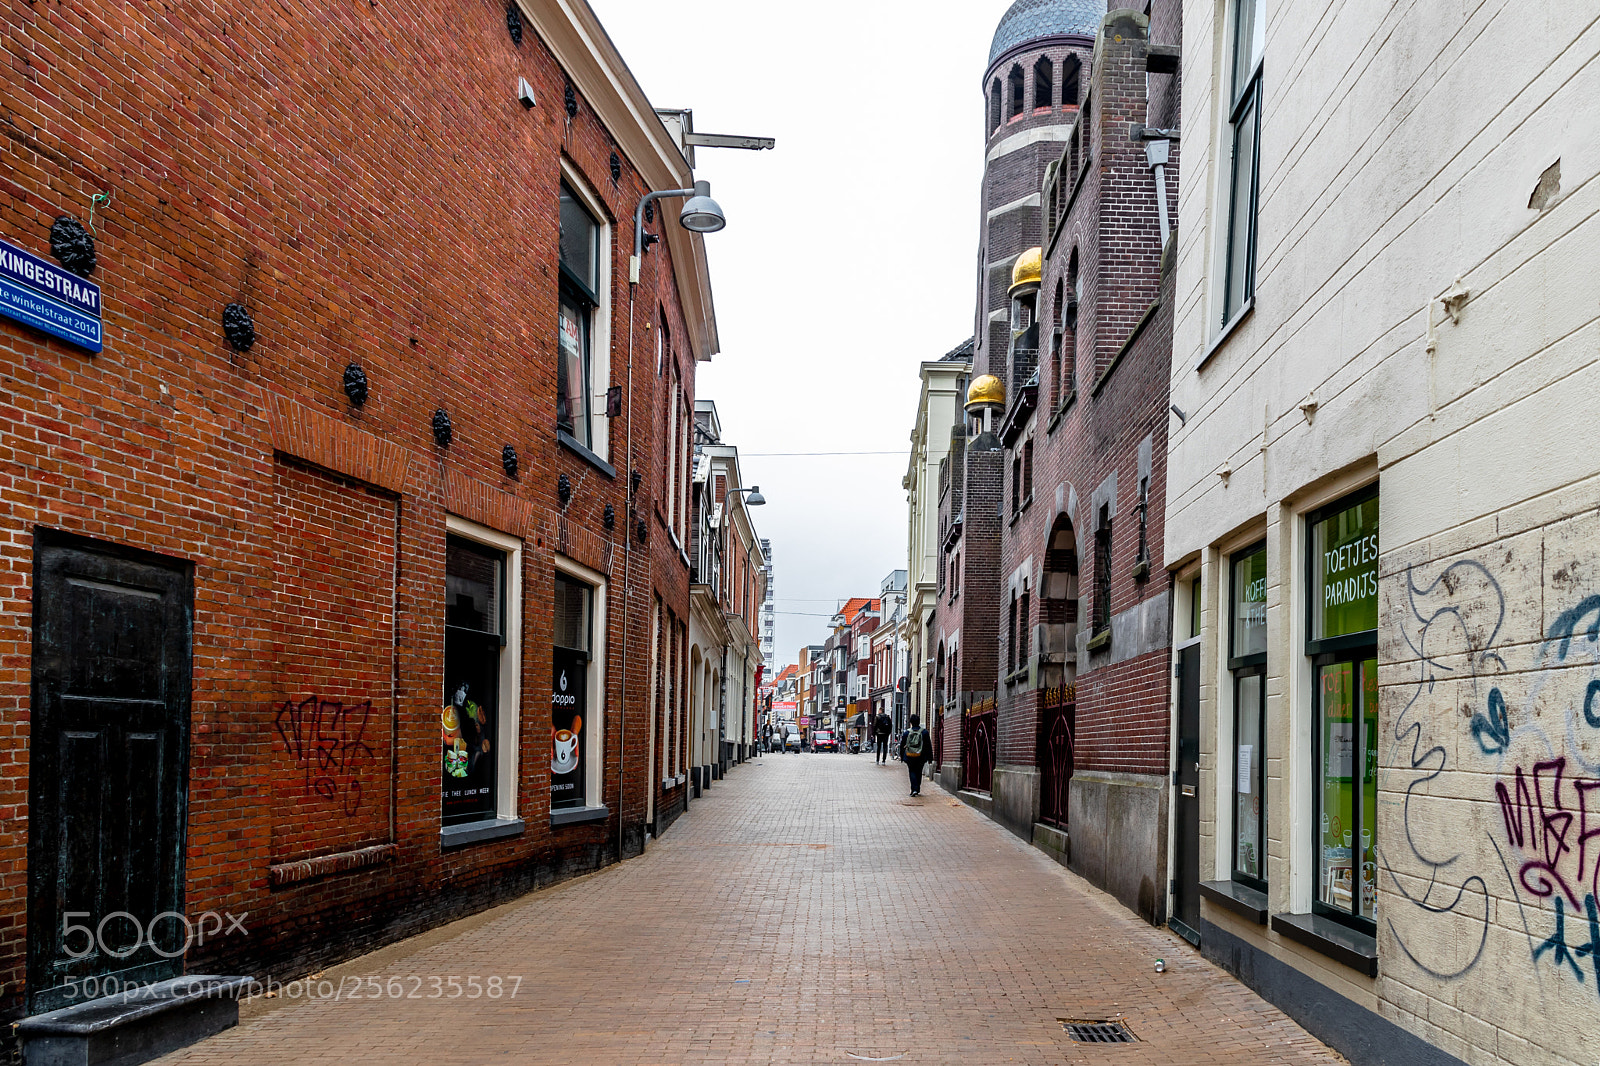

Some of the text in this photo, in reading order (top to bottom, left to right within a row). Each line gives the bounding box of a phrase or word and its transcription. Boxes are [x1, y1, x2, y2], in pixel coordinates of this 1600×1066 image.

[12, 293, 73, 327] winkelstraat
[74, 318, 96, 336] 2014
[565, 318, 578, 342] AM
[1324, 534, 1378, 575] TOETJES
[1325, 570, 1378, 608] PARADIJS
[1321, 670, 1351, 695] TOET
[552, 691, 575, 706] doppio
[464, 788, 477, 796] LUNCH
